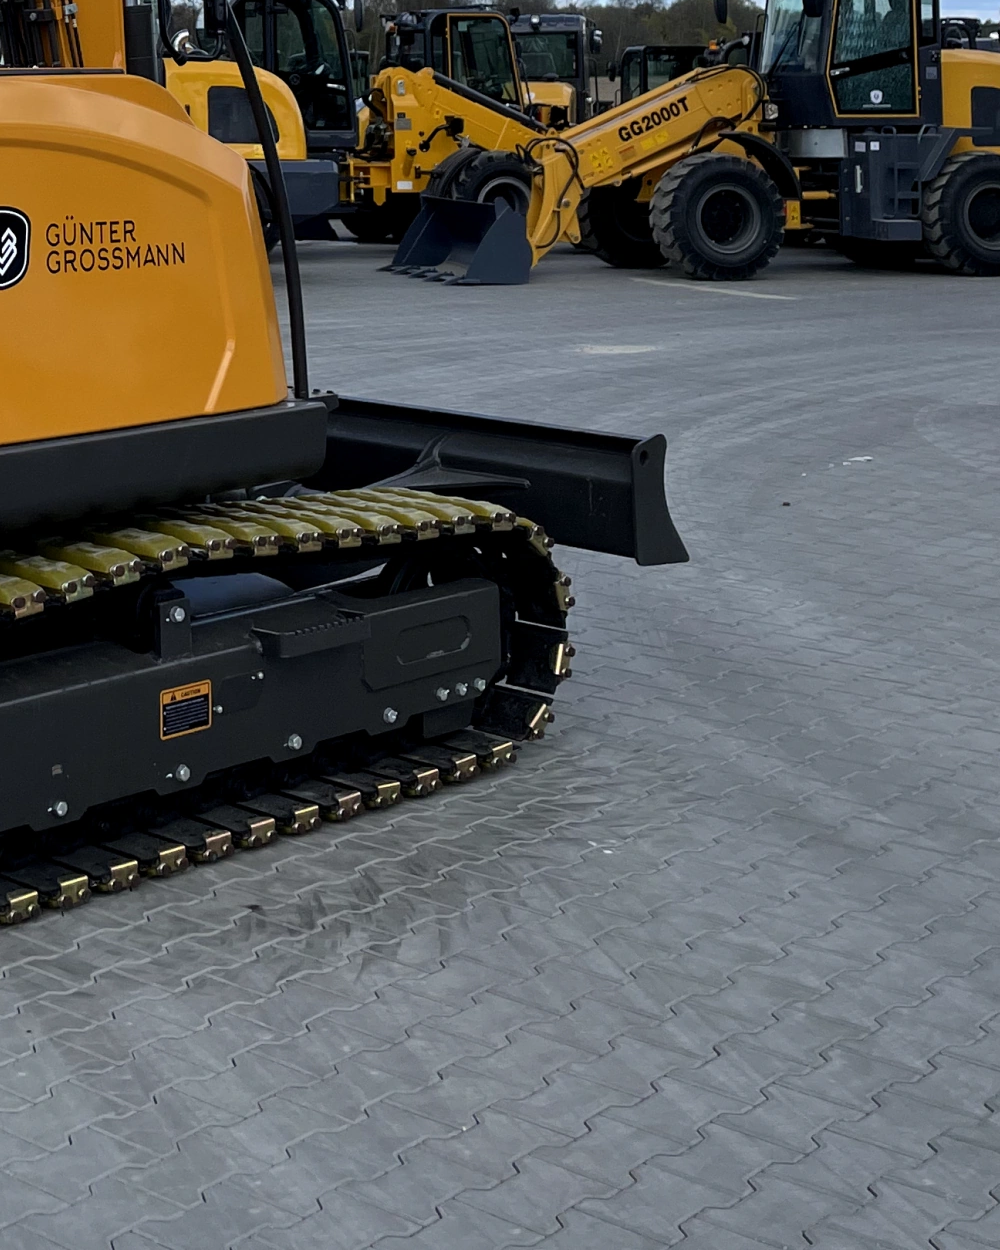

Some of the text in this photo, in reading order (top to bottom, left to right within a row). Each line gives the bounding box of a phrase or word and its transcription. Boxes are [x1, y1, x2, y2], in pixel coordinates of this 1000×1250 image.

[618, 96, 689, 142] GG2000T
[45, 215, 137, 247] GÜNTER
[46, 242, 186, 274] GROSSMANN
